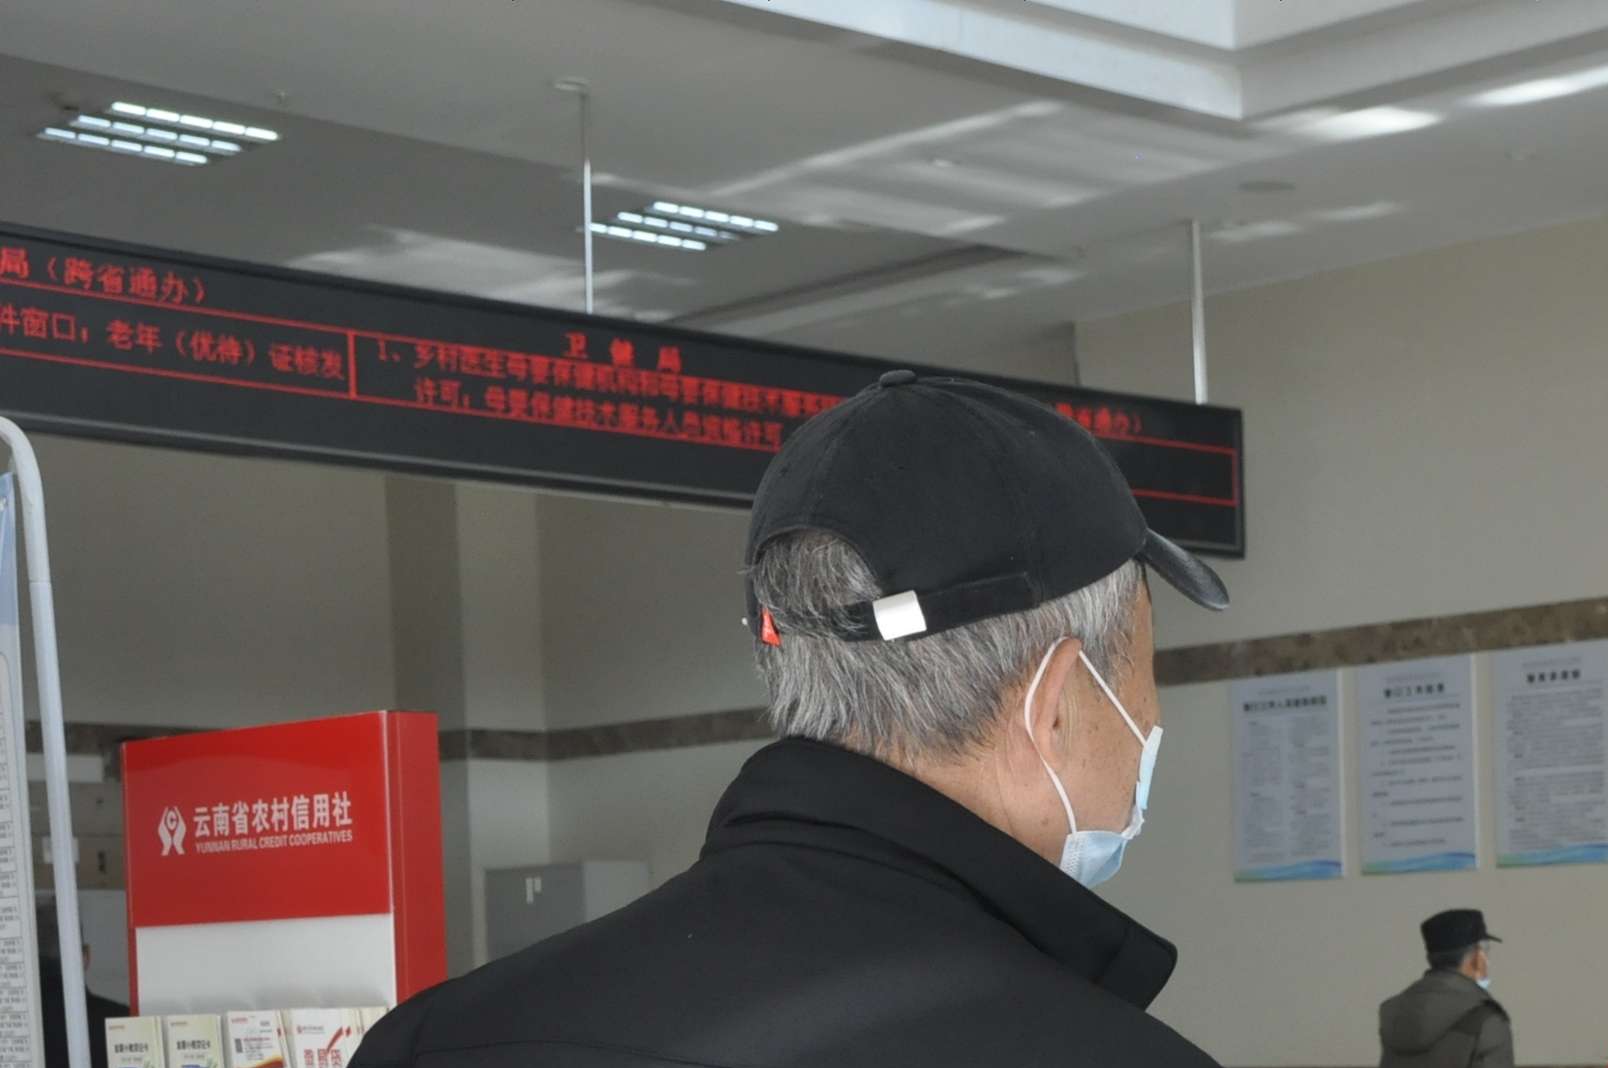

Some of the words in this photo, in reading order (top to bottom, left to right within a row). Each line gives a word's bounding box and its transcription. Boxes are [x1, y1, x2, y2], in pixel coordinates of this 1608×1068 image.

[193, 791, 352, 838] 云南省农村信用社
[231, 837, 258, 851] RURAL
[259, 834, 288, 849] CREDIT
[289, 829, 353, 846] COOPERATIVES
